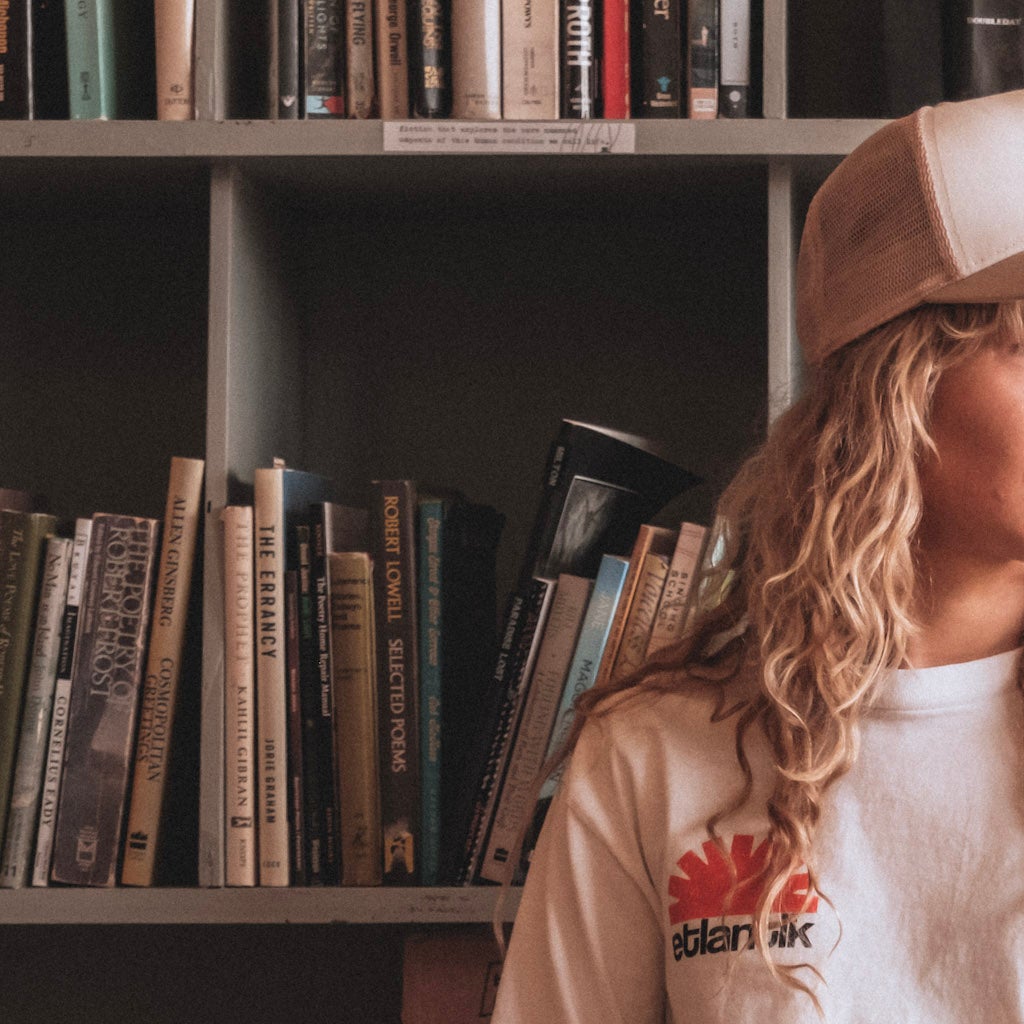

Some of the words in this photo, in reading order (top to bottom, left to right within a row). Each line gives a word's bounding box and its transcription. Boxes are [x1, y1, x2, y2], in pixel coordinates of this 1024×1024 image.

[351, 2, 366, 46] FLYING
[566, 5, 592, 66] ROTH
[966, 16, 1022, 26] DOUBLEDAY
[389, 33, 401, 66] Orwell
[546, 445, 565, 487] MILTON
[168, 495, 187, 546] ALLEN
[236, 523, 249, 561] THE
[260, 524, 276, 560] THE
[384, 495, 401, 555] ROBERT
[100, 525, 131, 618] ROBERT
[127, 525, 151, 572] THE
[43, 573, 61, 599] Man
[158, 548, 180, 628] GINSBERG
[315, 595, 327, 623] Poetry
[316, 576, 326, 594] The
[385, 560, 402, 623] LOWELL
[114, 580, 145, 673] POETRY
[235, 572, 249, 663] PROPHET
[260, 570, 277, 659] ERRANCY
[317, 625, 328, 652] Home
[499, 596, 523, 651] PARADISE
[89, 625, 119, 698] FROST
[318, 653, 329, 682] Repair
[388, 638, 406, 714] SELECTED
[491, 651, 508, 682] LOST
[137, 673, 159, 764] GREETINGS
[147, 657, 175, 782] COSMOPOLITAN
[236, 686, 249, 743] KAHLIL
[319, 683, 332, 718] Manual
[47, 696, 68, 783] CORNELIUS
[264, 737, 276, 772] JORIE
[390, 718, 407, 774] POEMS
[236, 747, 249, 808] GIBRAN
[264, 776, 276, 825] GRAHAM
[41, 788, 57, 827] EADY
